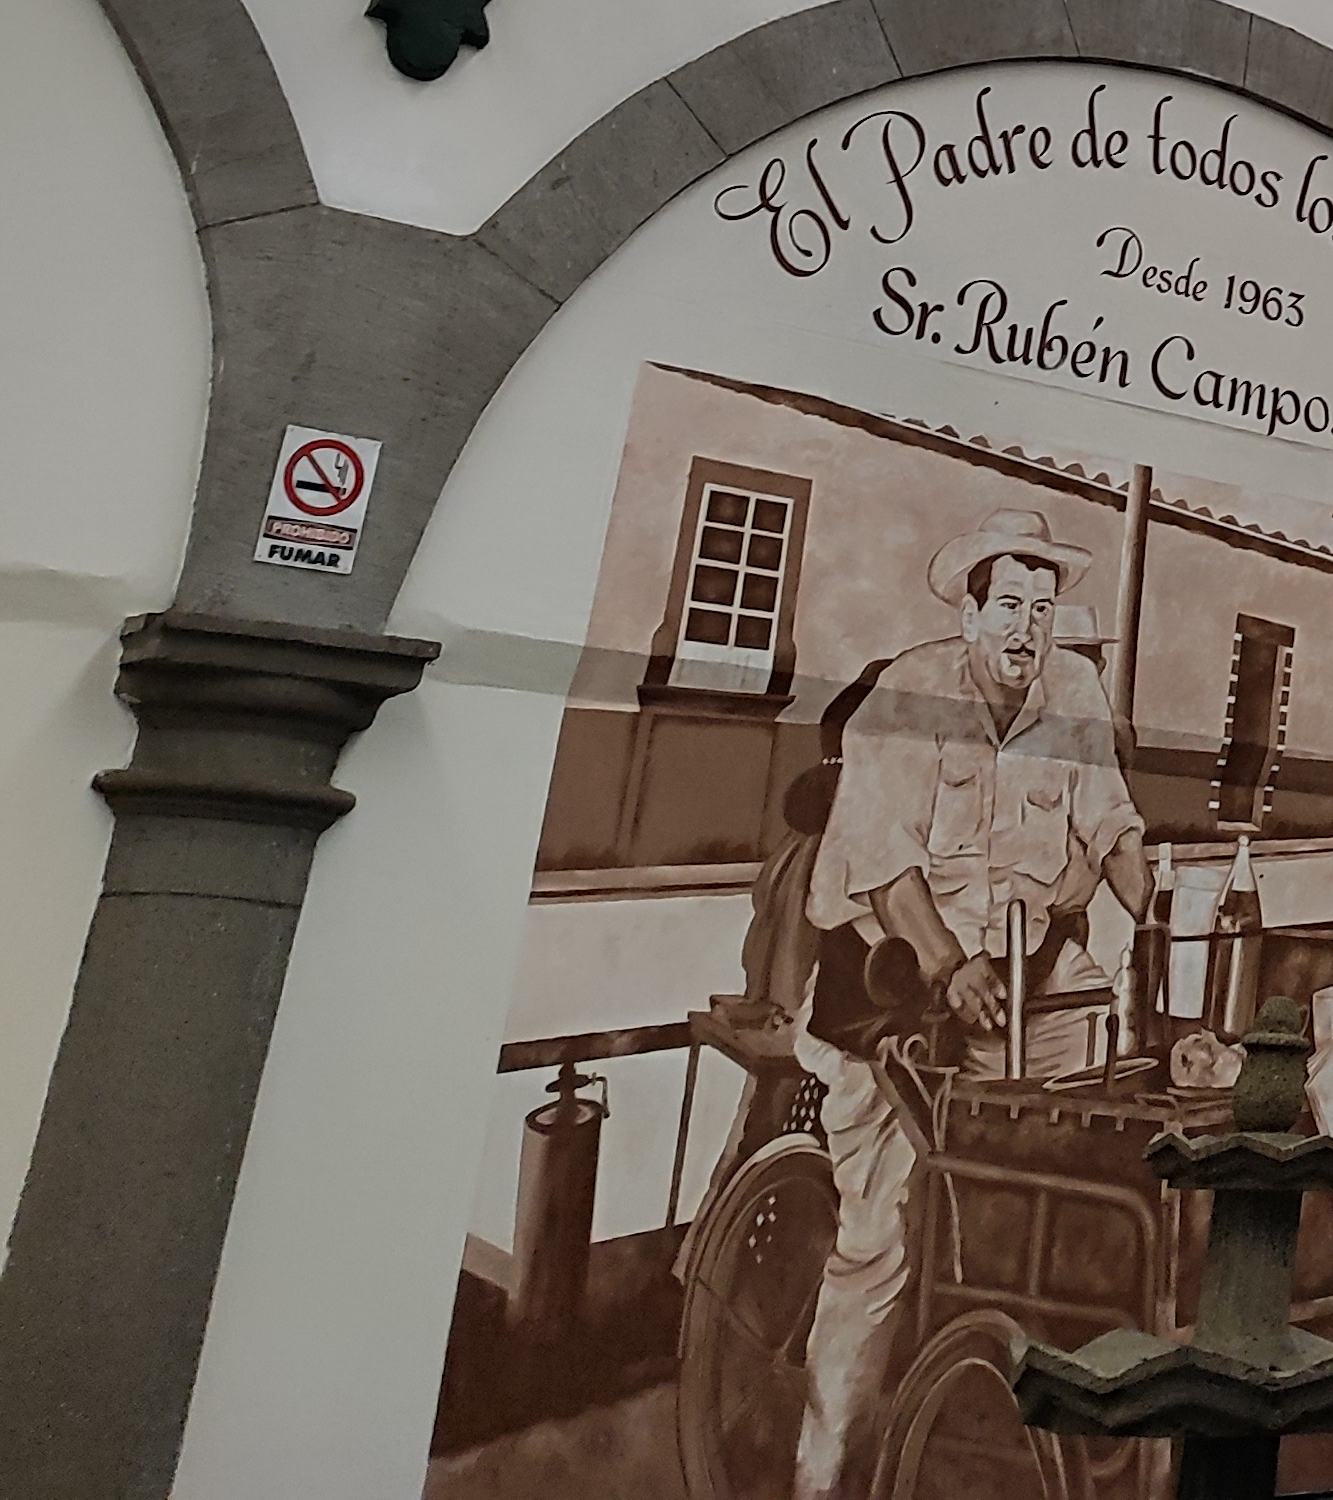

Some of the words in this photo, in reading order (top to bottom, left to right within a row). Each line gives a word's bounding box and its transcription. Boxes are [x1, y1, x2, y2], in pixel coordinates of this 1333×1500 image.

[714, 138, 851, 277] El
[841, 87, 1054, 244] Padre
[1071, 84, 1132, 170] de
[1146, 95, 1283, 209] todos
[872, 267, 945, 344] Sr.
[953, 280, 1132, 388] Rubén
[1095, 226, 1208, 302] Desde
[1223, 272, 1307, 328] 1963
[268, 545, 340, 568] FUMAR
